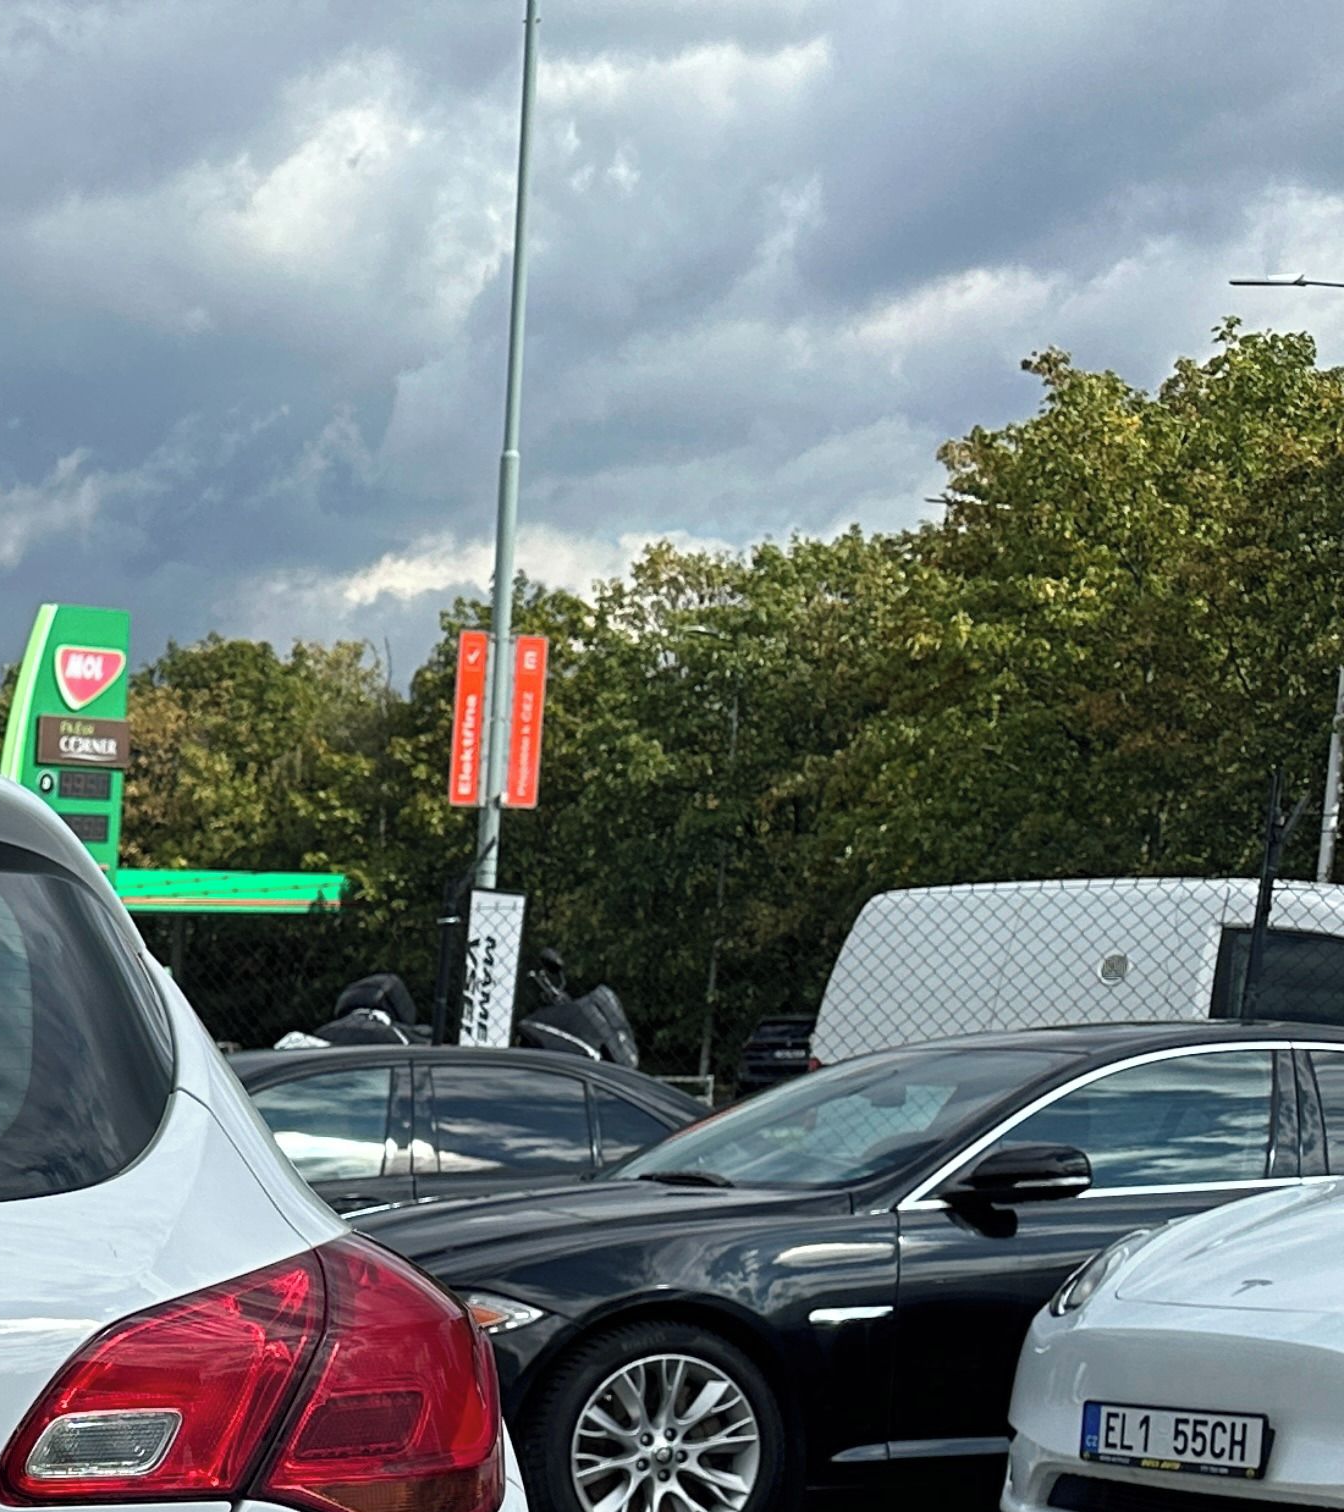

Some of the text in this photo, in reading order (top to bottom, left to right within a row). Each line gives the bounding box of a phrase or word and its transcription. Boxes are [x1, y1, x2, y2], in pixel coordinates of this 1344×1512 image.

[65, 653, 105, 681] MOL
[1104, 1412, 1248, 1462] EL1 55CH
